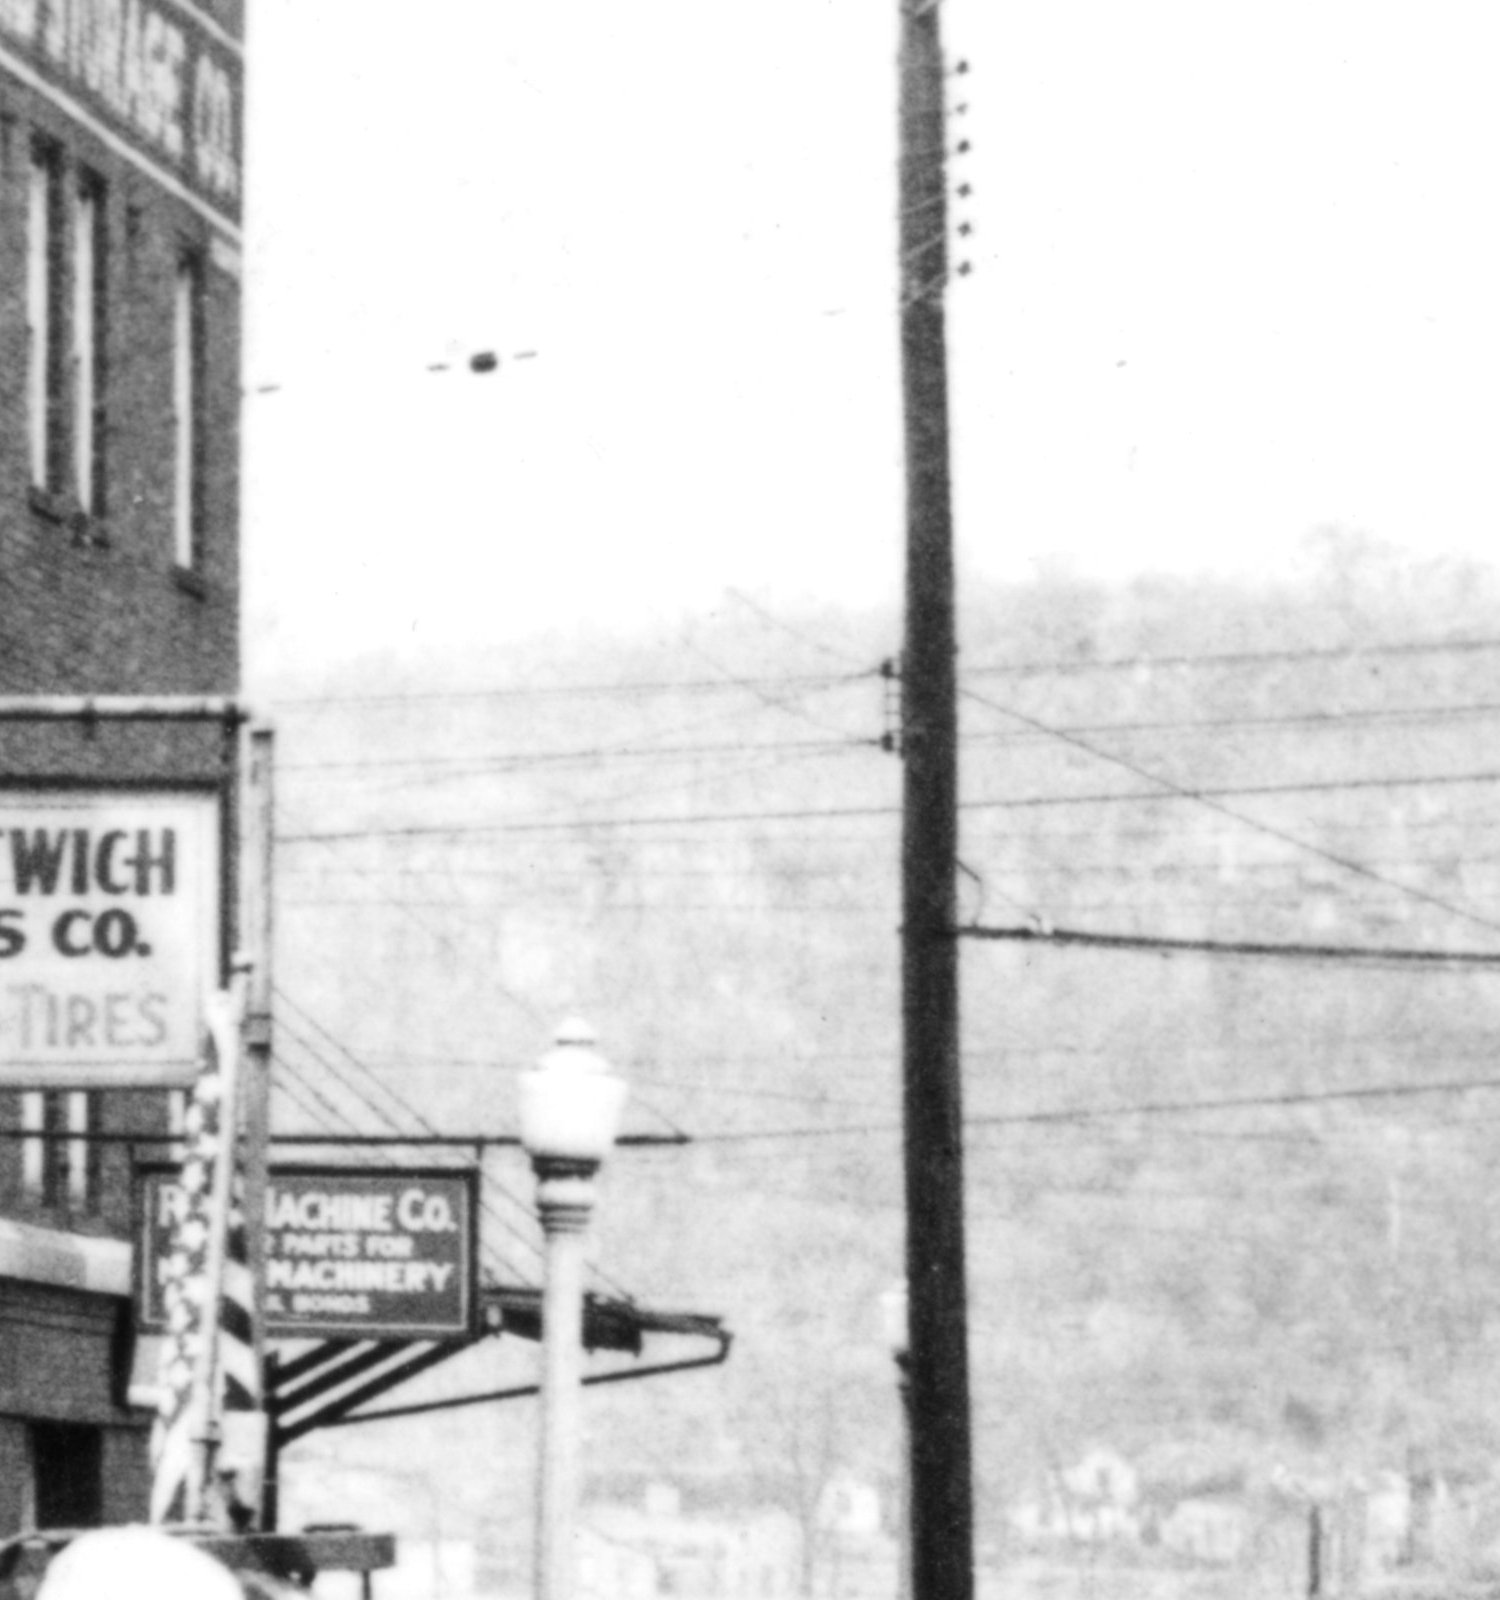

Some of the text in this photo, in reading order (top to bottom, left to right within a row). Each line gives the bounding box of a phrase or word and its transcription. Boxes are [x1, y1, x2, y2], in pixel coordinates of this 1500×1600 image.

[52, 907, 153, 959] CO.
[282, 1232, 360, 1258] PARTS
[365, 1234, 415, 1259] FOR
[267, 1258, 455, 1293] MACHINERY
